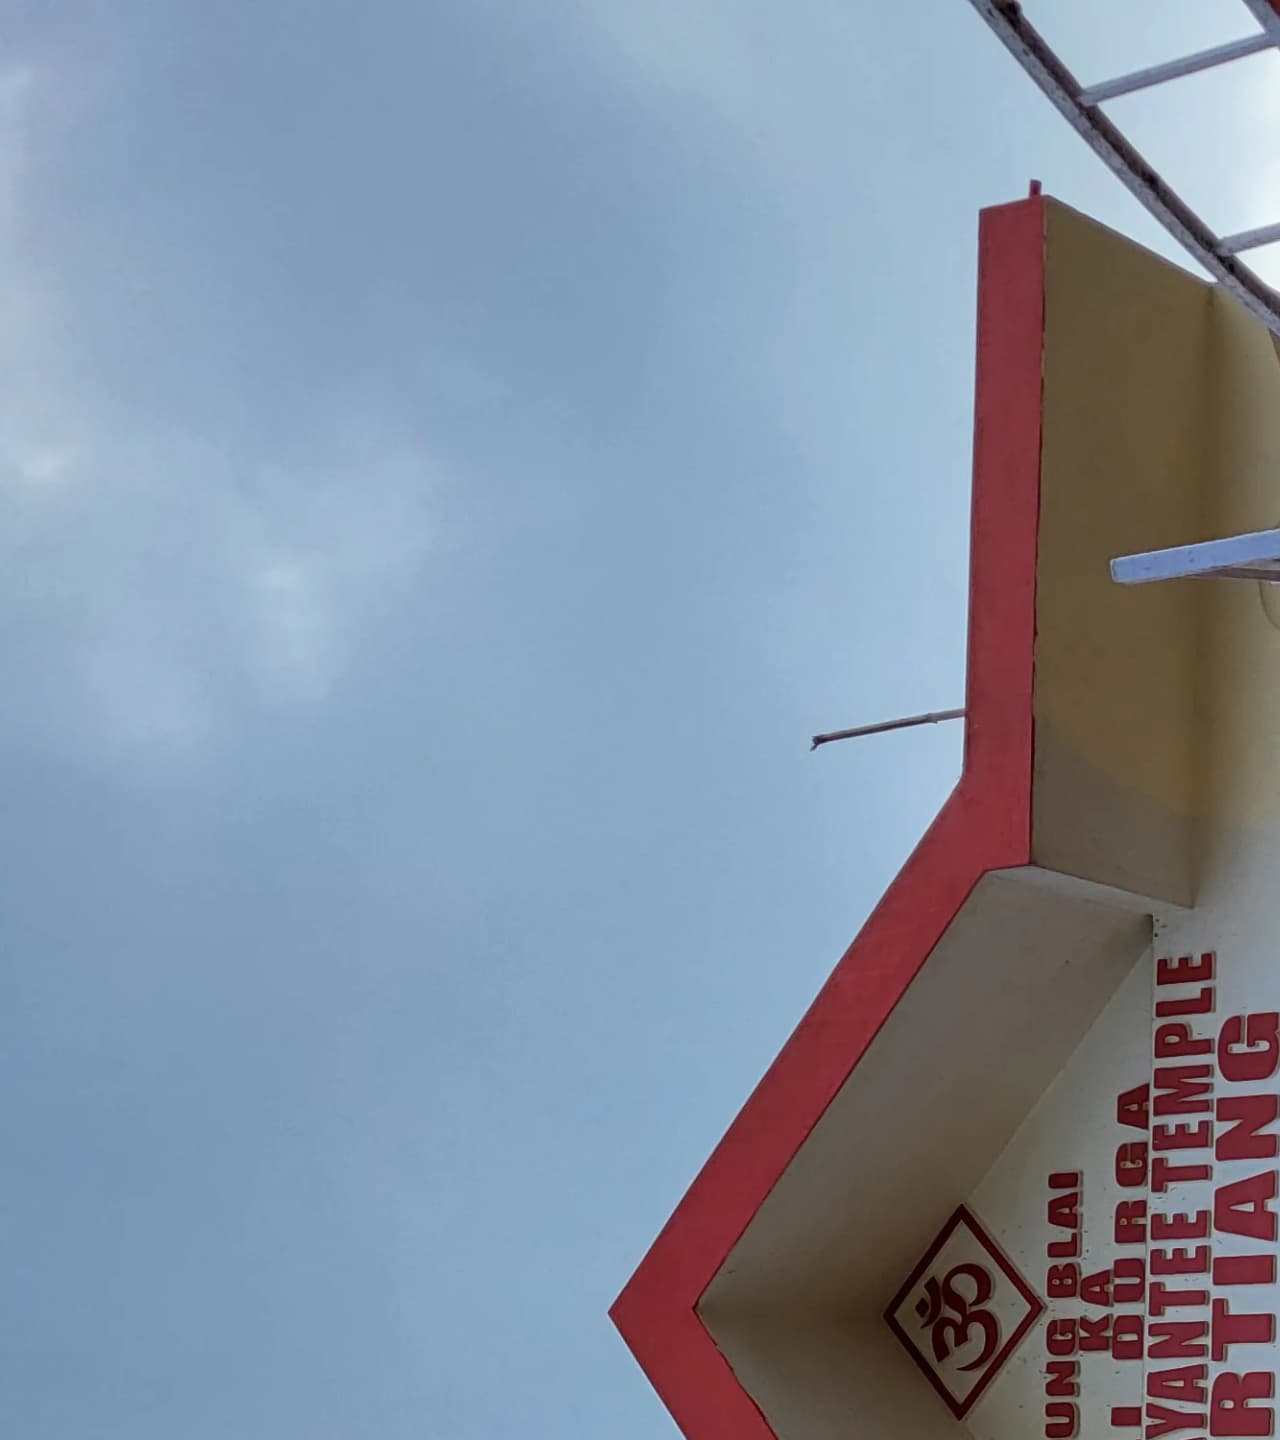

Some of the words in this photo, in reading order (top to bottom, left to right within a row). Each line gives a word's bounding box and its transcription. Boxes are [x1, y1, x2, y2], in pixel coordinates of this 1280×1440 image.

[1151, 952, 1217, 1192] TEMPLE
[1048, 1172, 1081, 1298] BLAI
[1076, 1268, 1112, 1352] KA
[1111, 1083, 1150, 1360] DURGA
